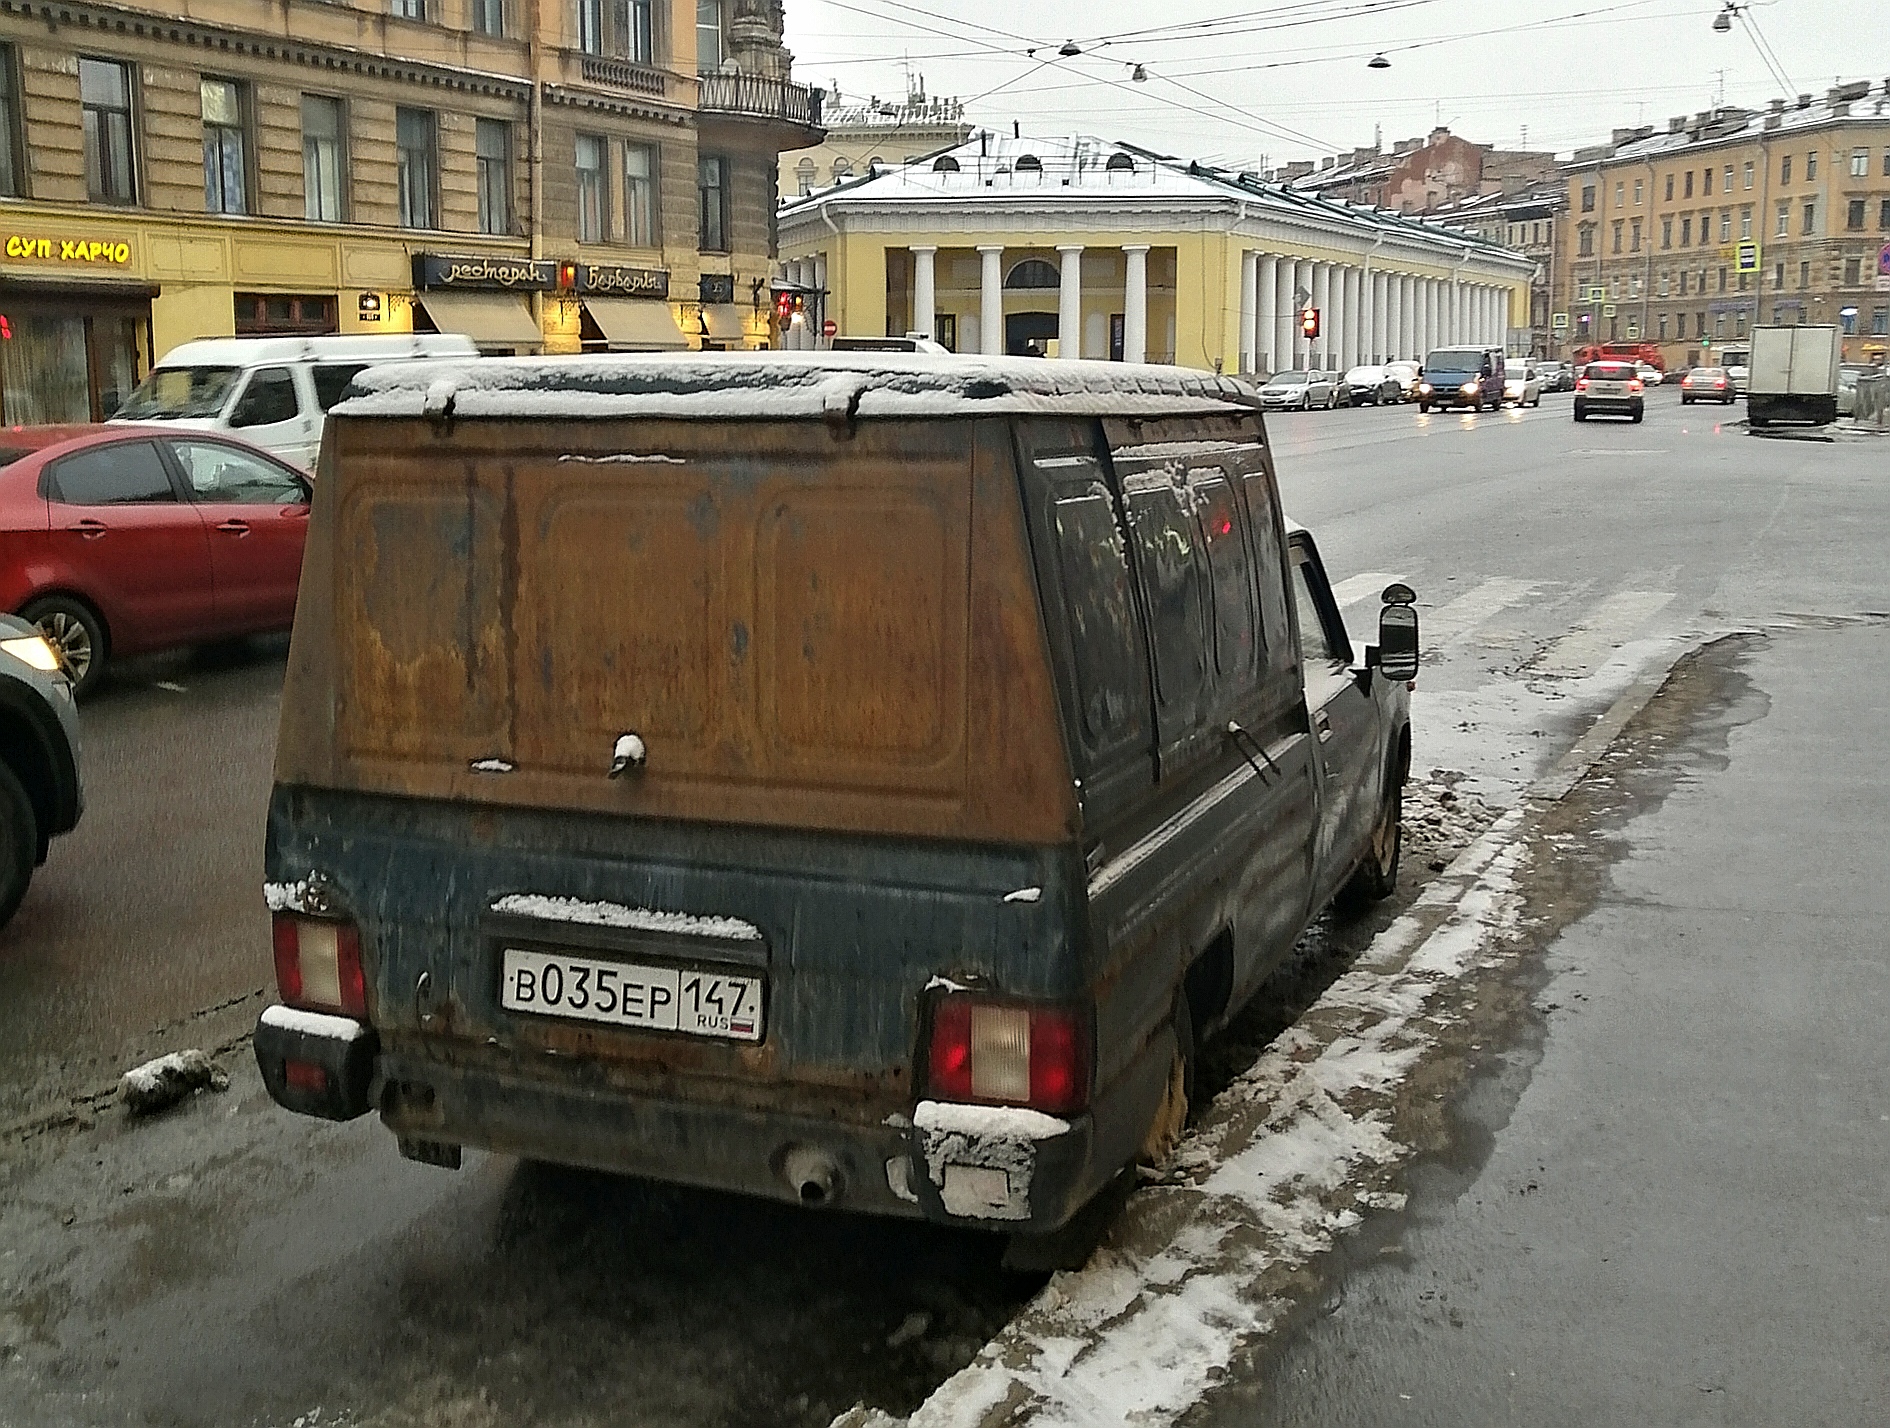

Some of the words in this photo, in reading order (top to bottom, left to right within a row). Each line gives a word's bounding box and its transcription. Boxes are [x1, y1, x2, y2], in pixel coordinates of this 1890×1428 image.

[6, 235, 52, 258] СУП
[61, 240, 129, 263] ХАРЧО
[438, 259, 548, 286] ресторан
[684, 977, 748, 1016] 147
[697, 1014, 729, 1030] RUS
